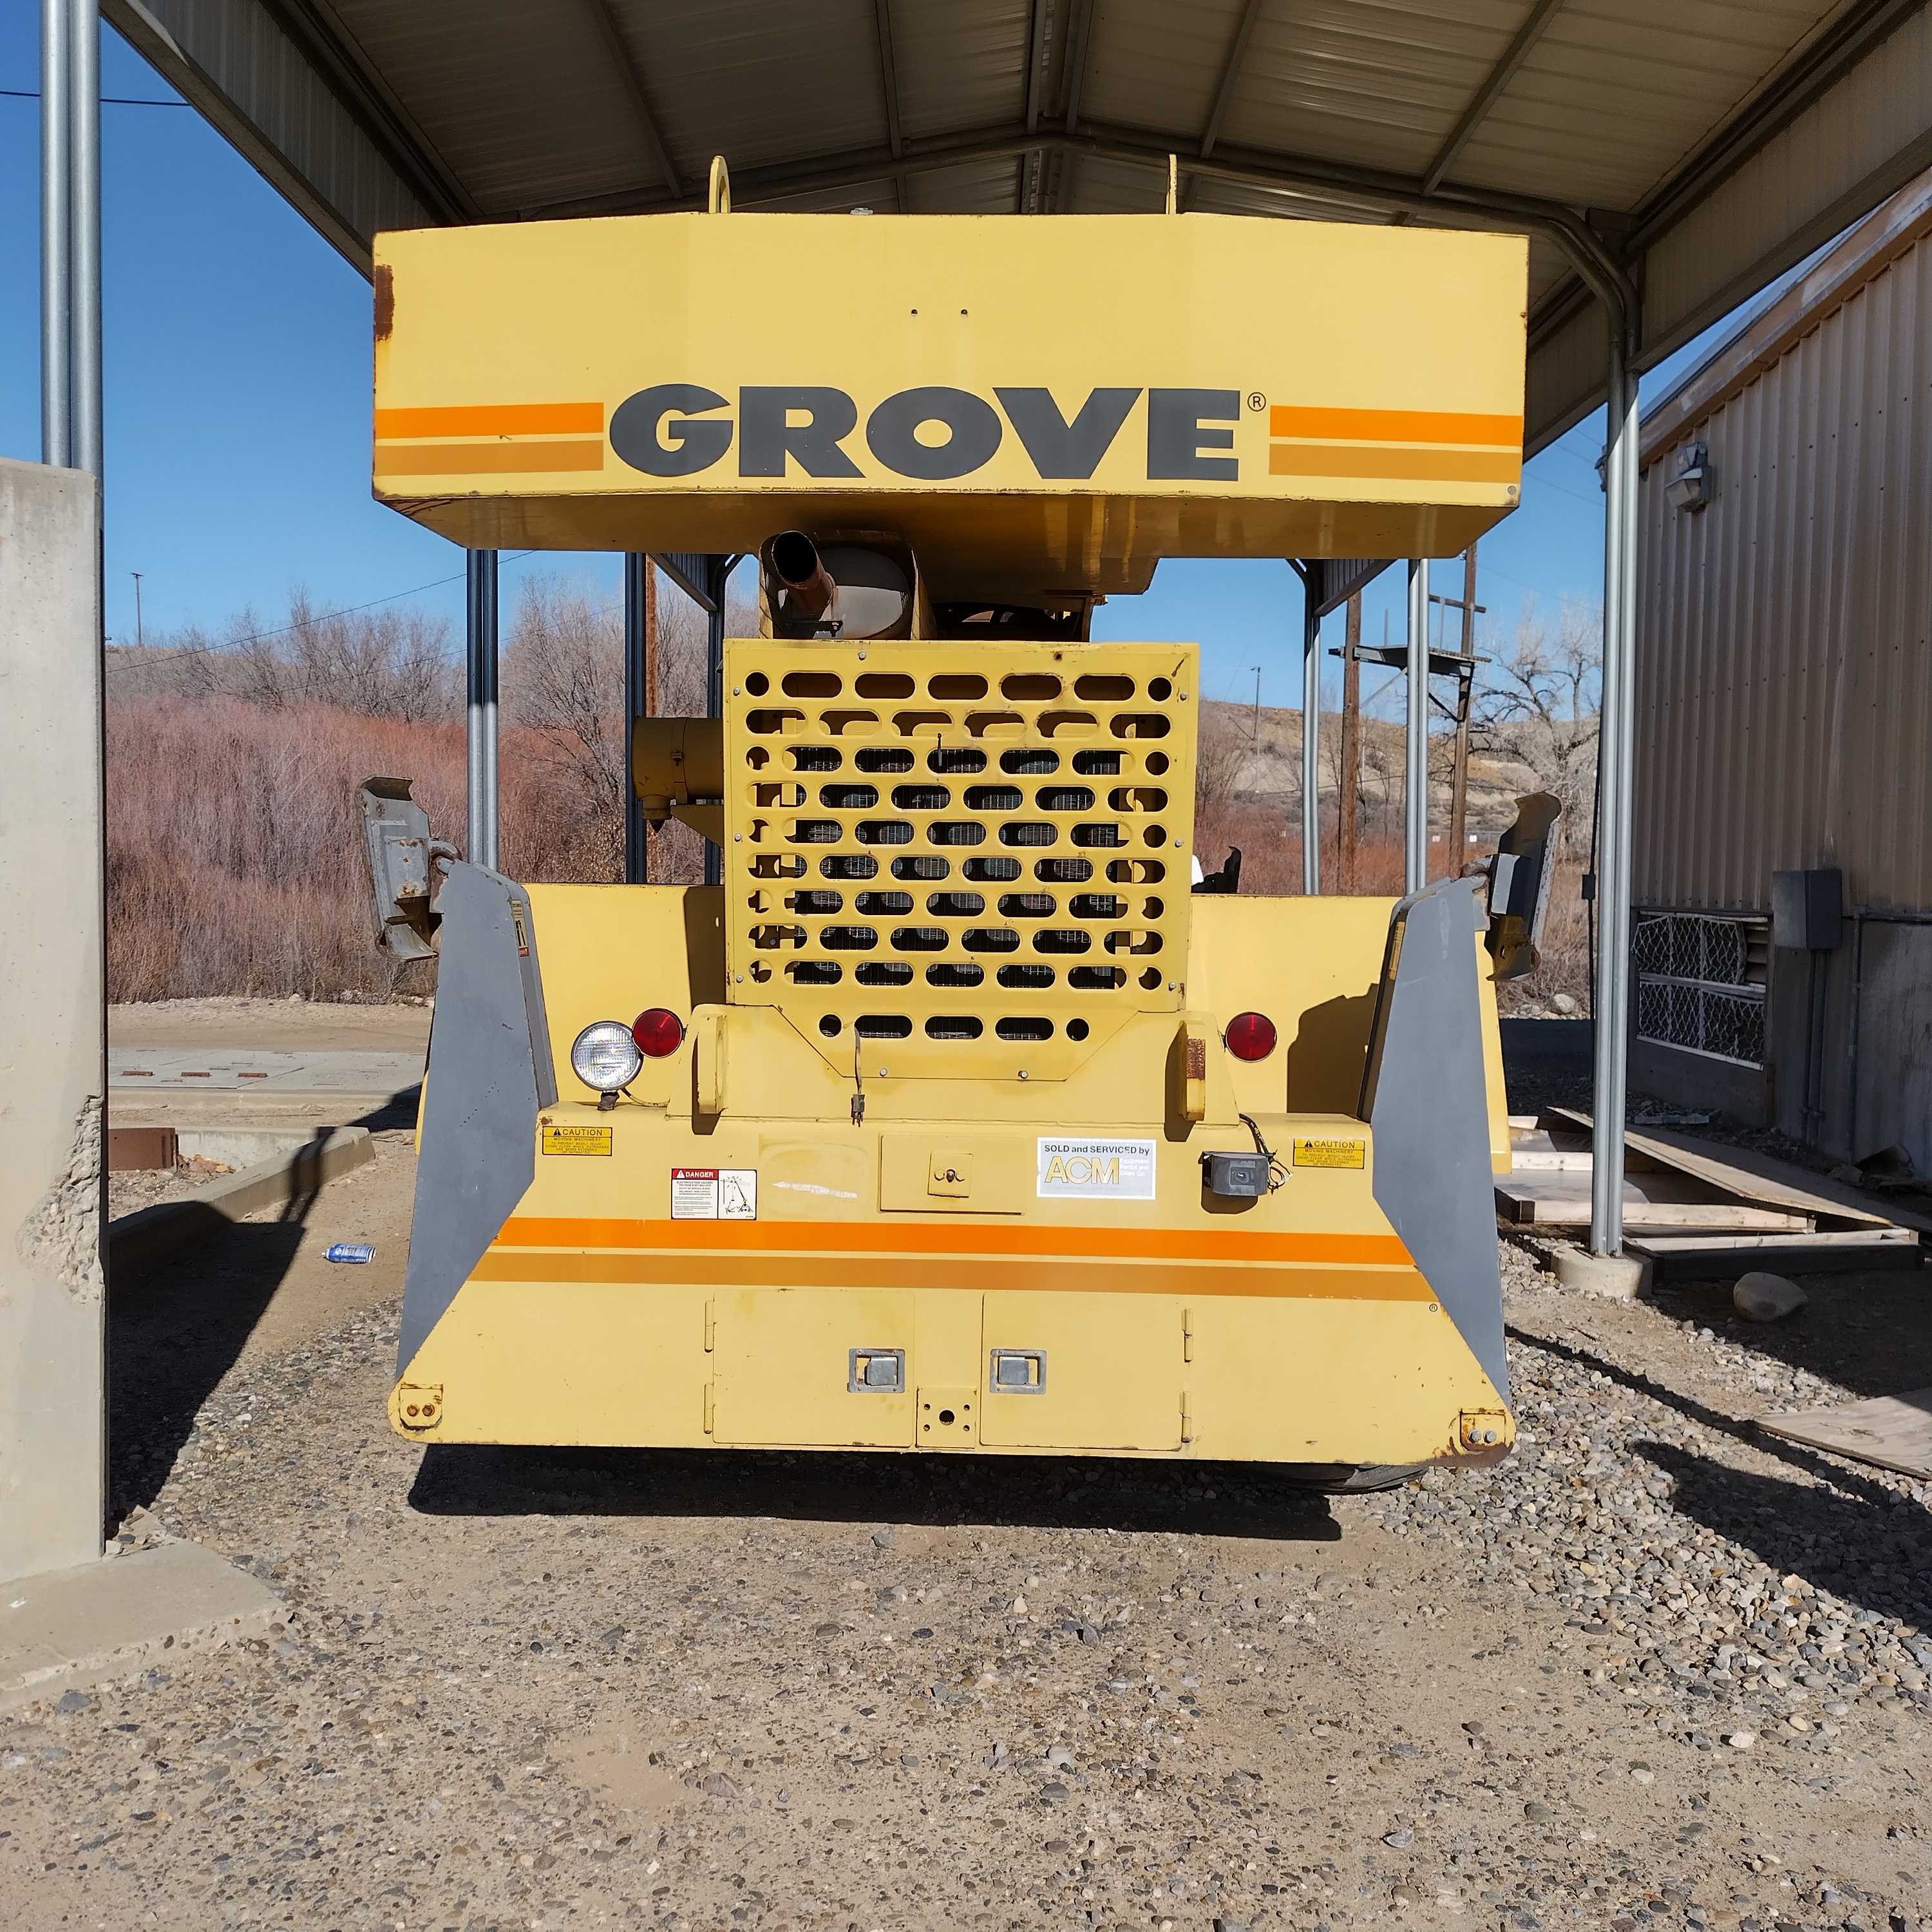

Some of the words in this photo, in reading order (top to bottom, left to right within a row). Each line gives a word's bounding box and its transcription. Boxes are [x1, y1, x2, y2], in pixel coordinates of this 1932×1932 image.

[609, 384, 1240, 481] GROVE
[1139, 1146, 1150, 1156] by
[1044, 1156, 1119, 1184] ACM
